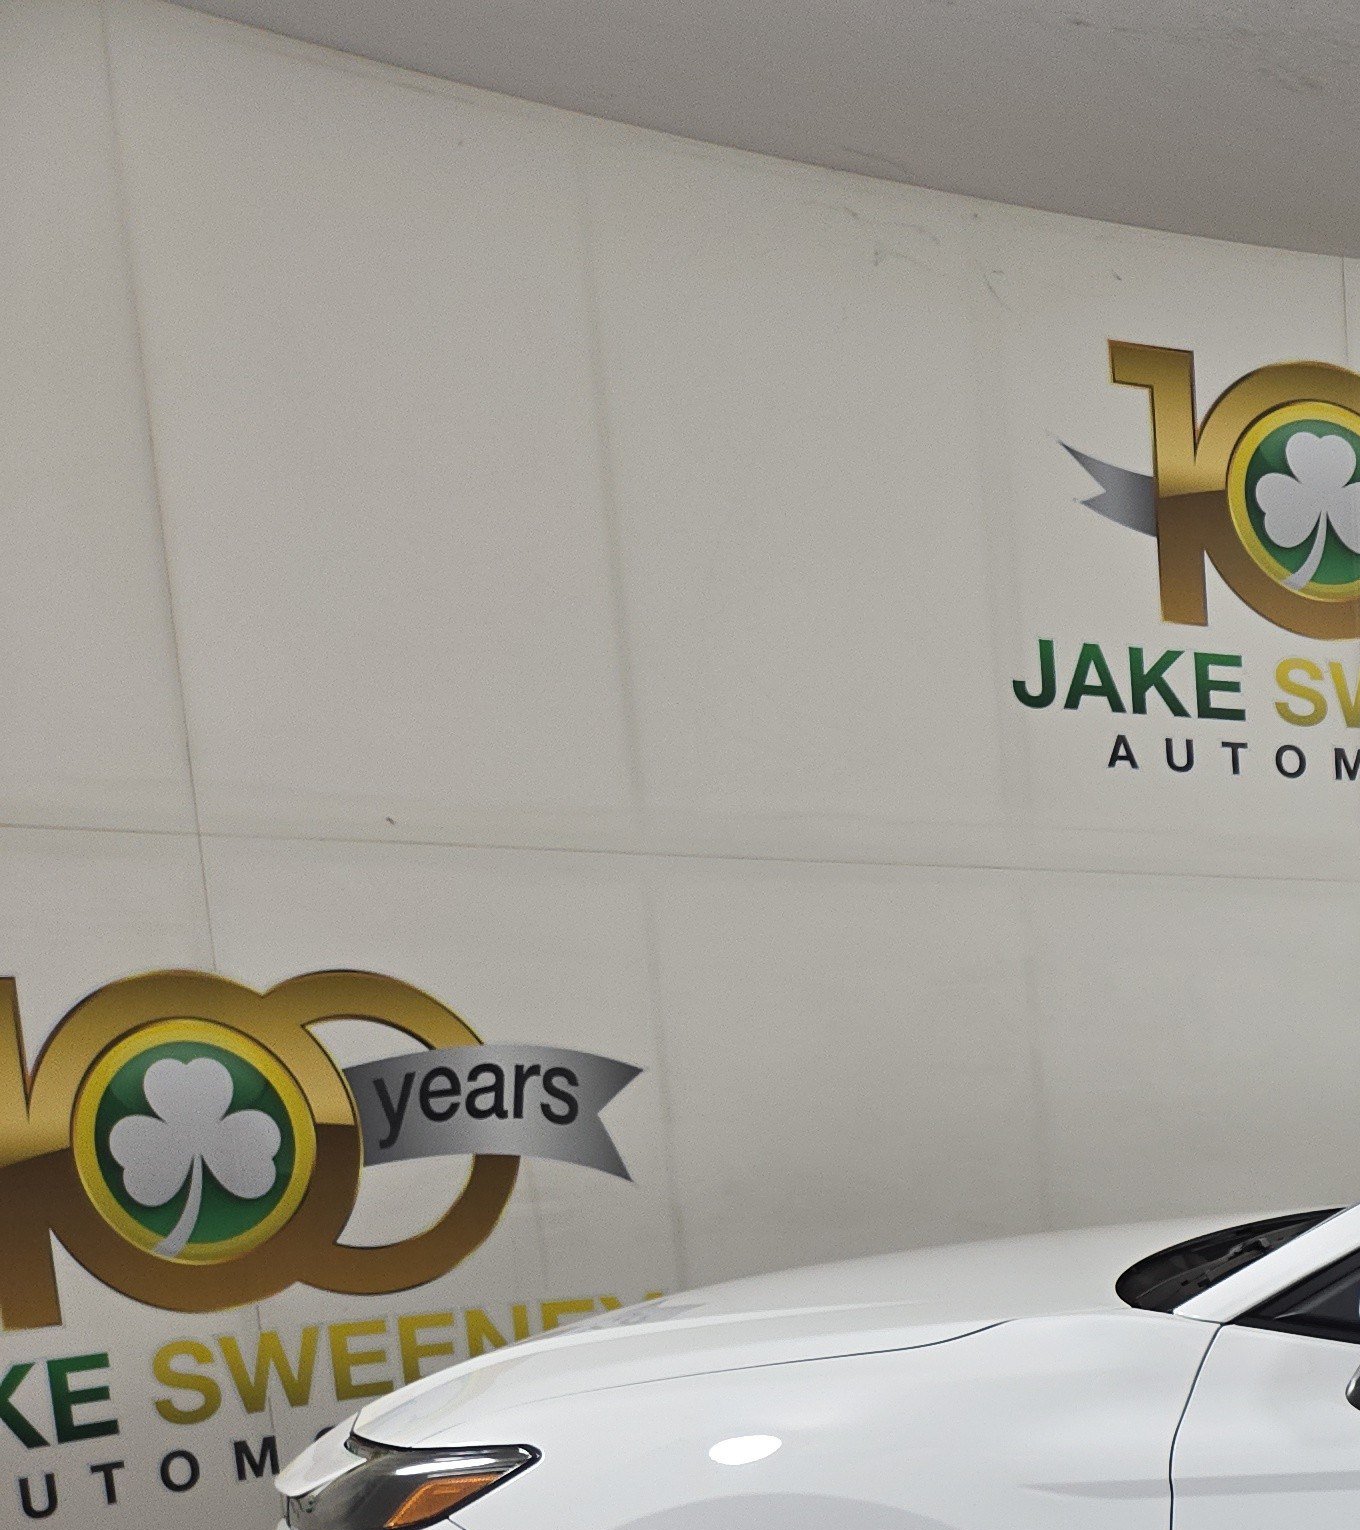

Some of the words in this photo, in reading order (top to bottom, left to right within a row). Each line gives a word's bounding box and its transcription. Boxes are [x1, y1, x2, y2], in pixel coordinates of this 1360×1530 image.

[1012, 639, 1246, 721] JAKE
[373, 1063, 578, 1149] years
[0, 1352, 120, 1450] KE
[153, 1292, 664, 1425] SWEEN
